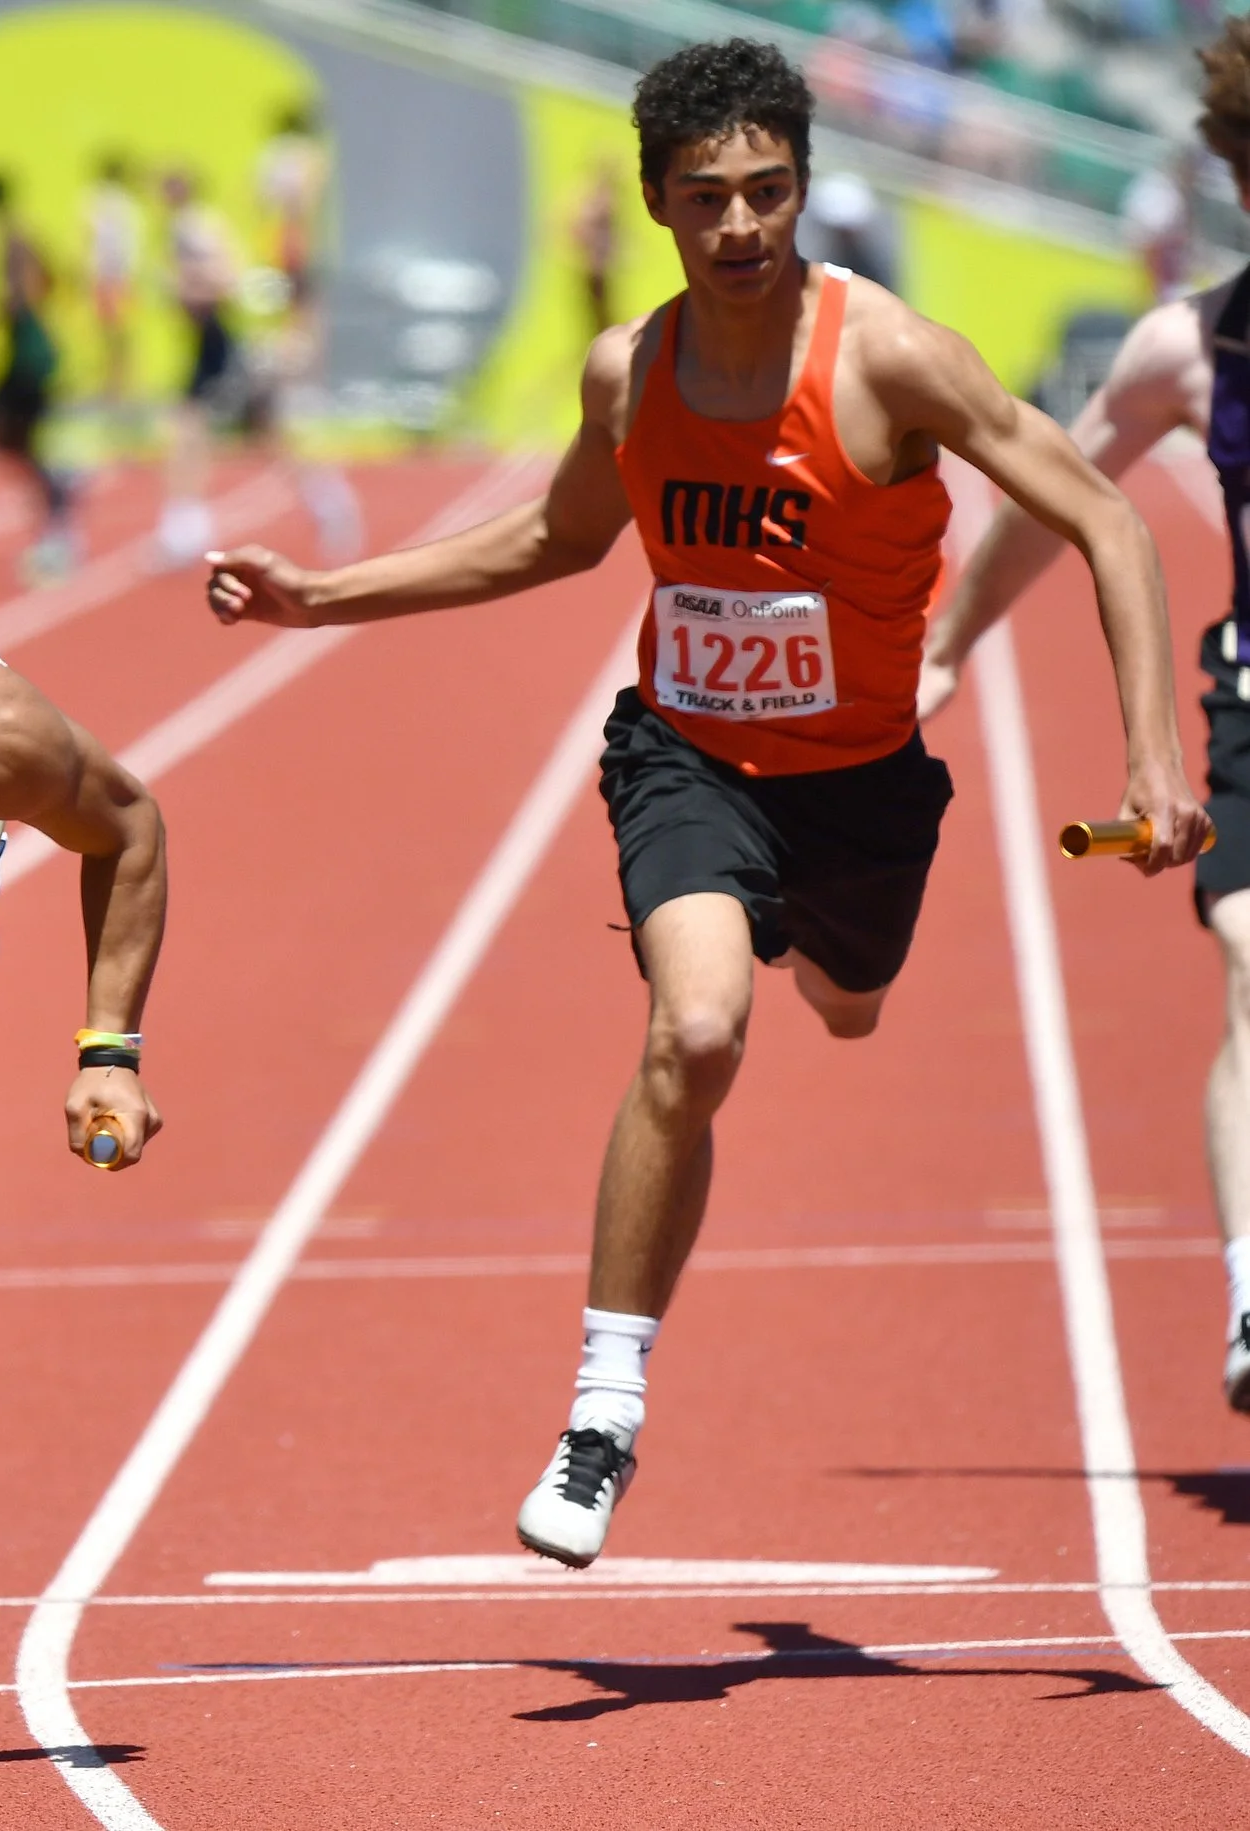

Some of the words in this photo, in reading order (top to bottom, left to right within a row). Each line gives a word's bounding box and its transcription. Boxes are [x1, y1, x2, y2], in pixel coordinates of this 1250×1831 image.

[661, 479, 811, 549] MHS
[673, 592, 722, 617] OSAA
[732, 599, 809, 619] OnPoint
[672, 624, 822, 692] 1226
[676, 690, 736, 711] TRACK
[742, 698, 755, 711] &
[761, 692, 816, 711] FIELD
